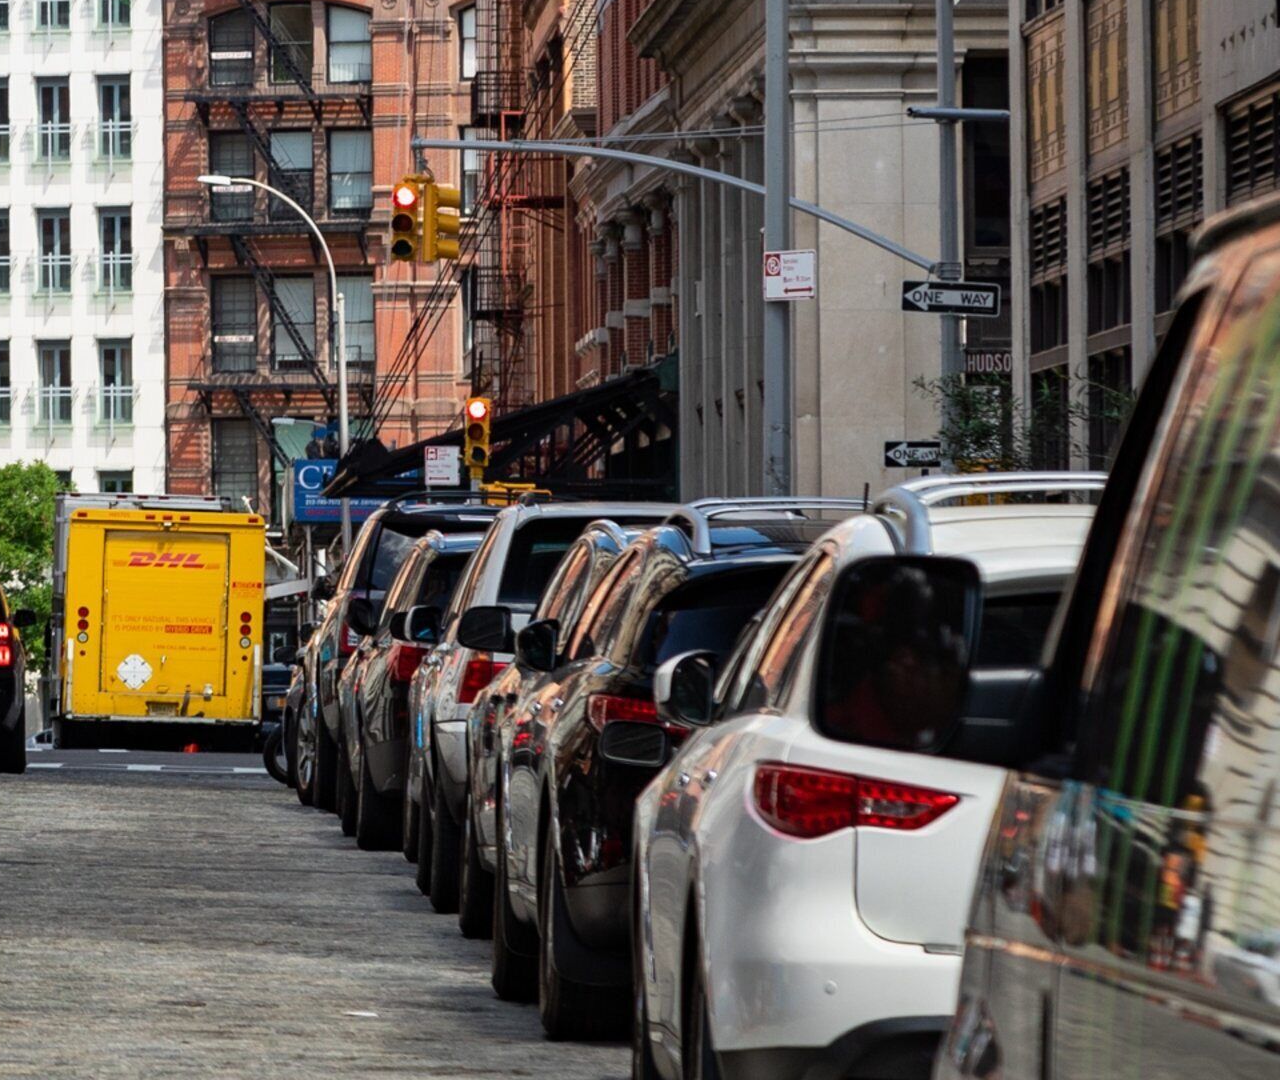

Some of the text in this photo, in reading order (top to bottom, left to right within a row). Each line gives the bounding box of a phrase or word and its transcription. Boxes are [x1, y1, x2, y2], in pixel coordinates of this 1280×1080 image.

[912, 290, 991, 305] ONE WAY
[967, 353, 1012, 372] HUDSO
[128, 551, 205, 568] DHL
[165, 625, 189, 633] HYBRID
